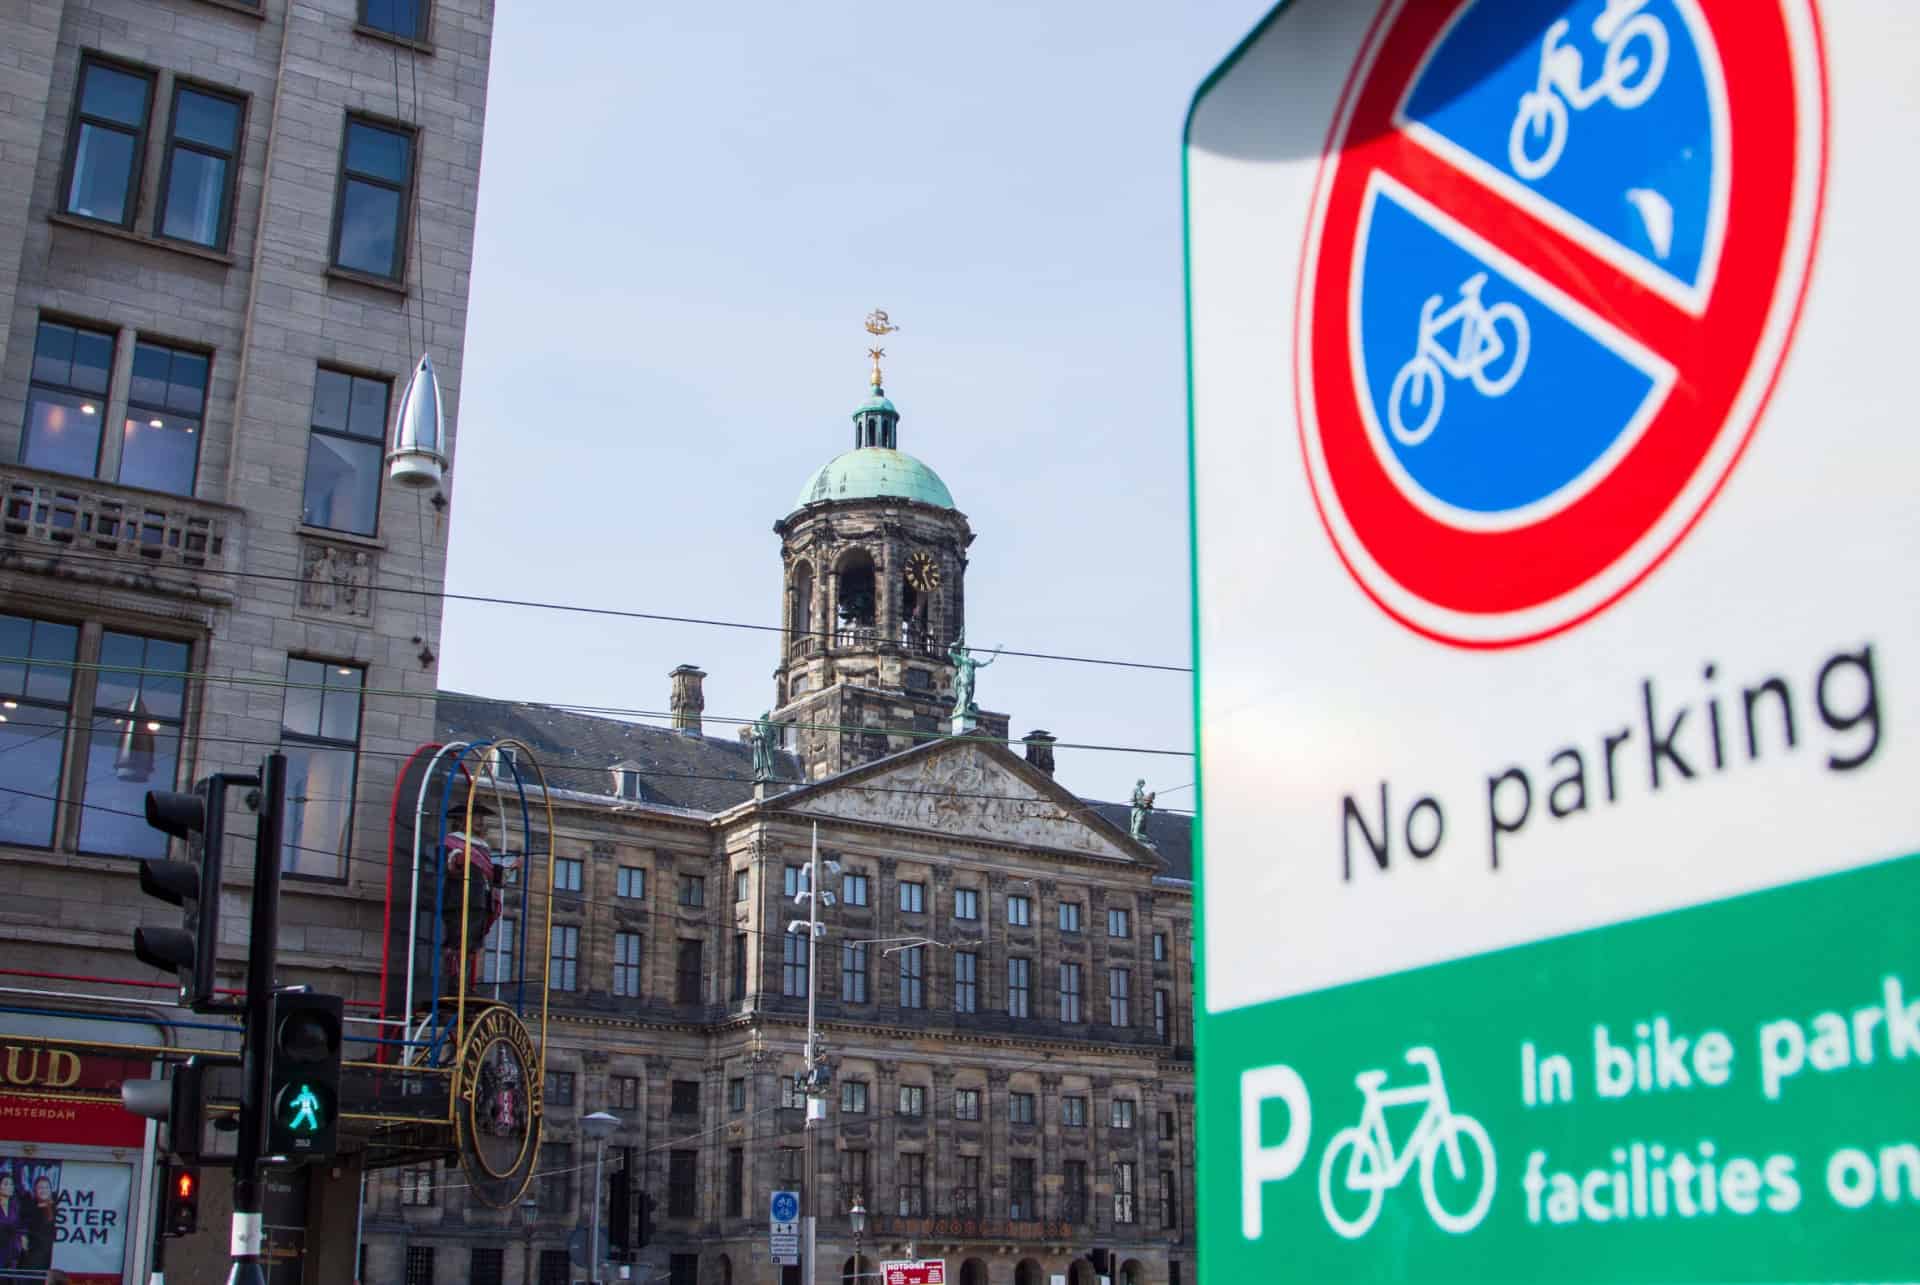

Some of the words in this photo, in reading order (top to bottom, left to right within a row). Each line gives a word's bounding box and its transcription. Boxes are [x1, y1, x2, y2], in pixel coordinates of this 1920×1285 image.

[1342, 782, 1443, 880] No
[1488, 646, 1883, 869] parking
[0, 1046, 81, 1088] UD
[1521, 1043, 1572, 1105] In
[1595, 1018, 1733, 1097] bike
[1240, 1064, 1312, 1240] P
[58, 1189, 95, 1207] AM
[1522, 1143, 1801, 1223] facilities
[1826, 1144, 1920, 1208] on
[55, 1226, 108, 1245] DAM
[56, 1207, 117, 1226] STER
